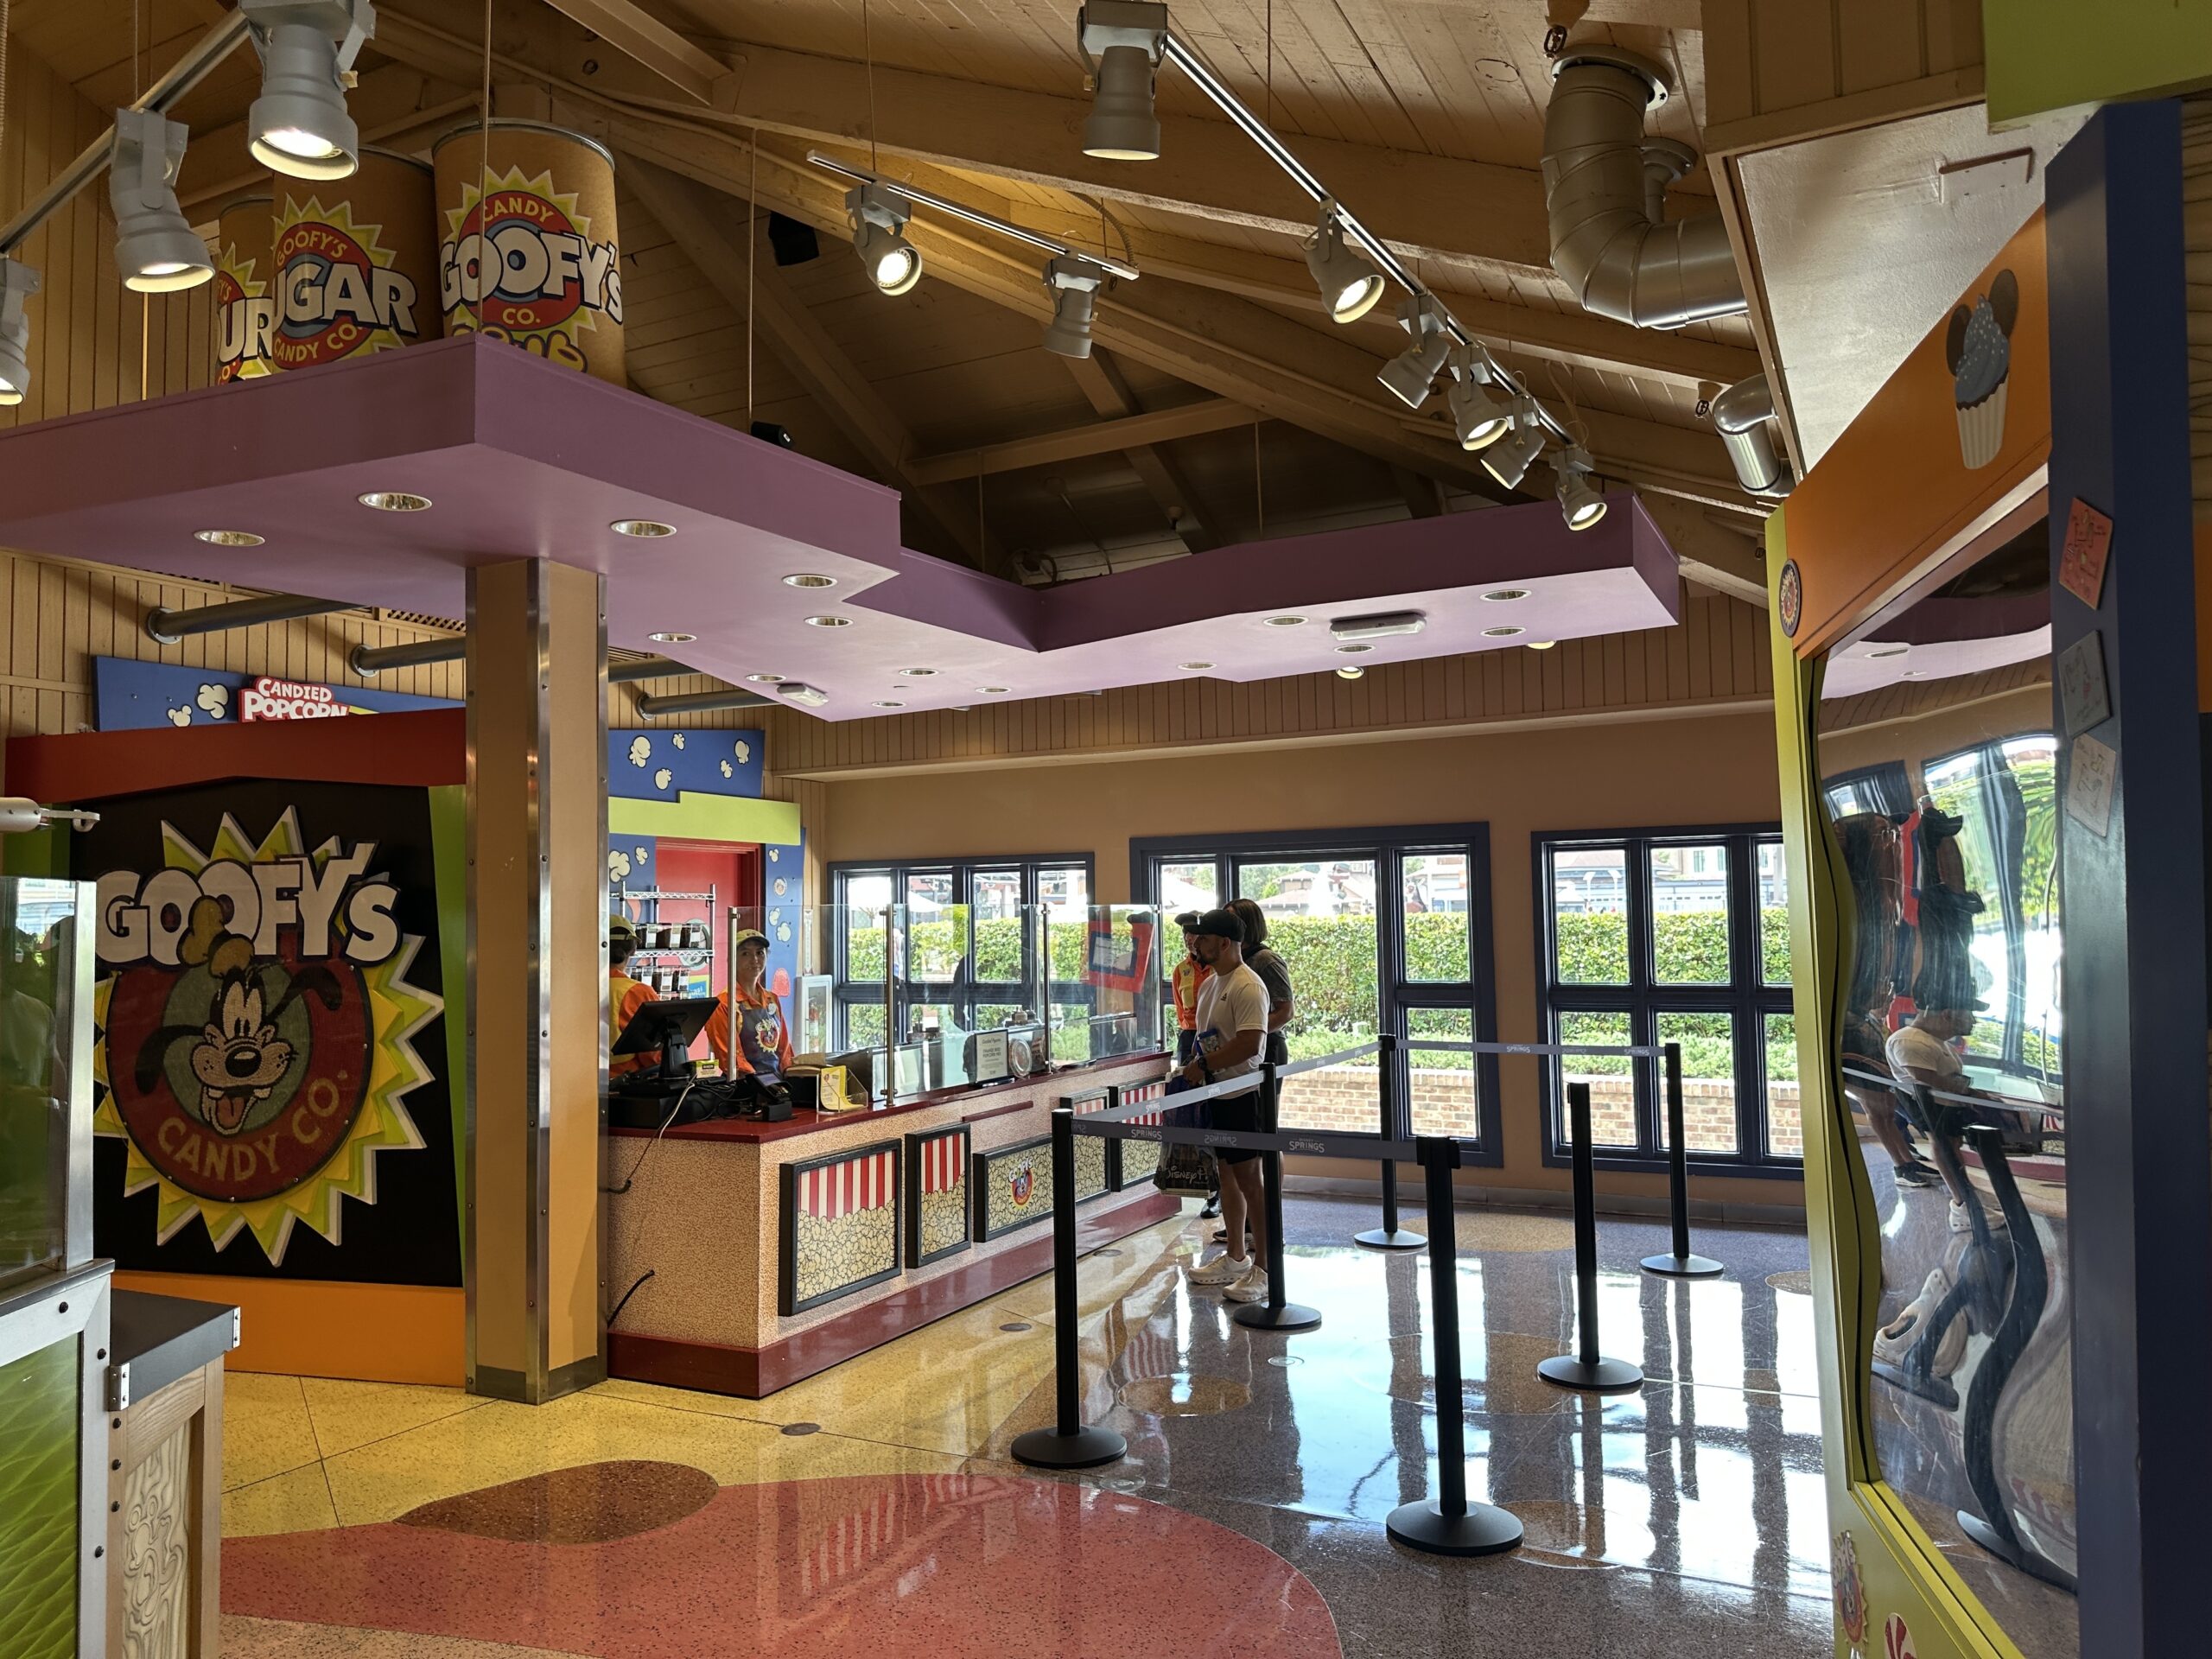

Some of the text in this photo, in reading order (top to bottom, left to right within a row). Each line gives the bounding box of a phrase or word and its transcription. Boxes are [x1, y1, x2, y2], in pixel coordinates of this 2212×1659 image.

[480, 197, 555, 223] CANDY
[277, 231, 347, 266] GOOFY'S
[441, 226, 623, 325] GOOFY'S
[502, 308, 541, 325] CO.
[274, 337, 319, 362] CANDY
[258, 678, 332, 702] CANDIED
[245, 690, 347, 720] POPCORN
[95, 842, 399, 966] GOOFY'S
[158, 1071, 348, 1182] CANDY CO.
[1131, 1128, 1163, 1141] SPRINGS
[1289, 1141, 1325, 1154] SPRINGS
